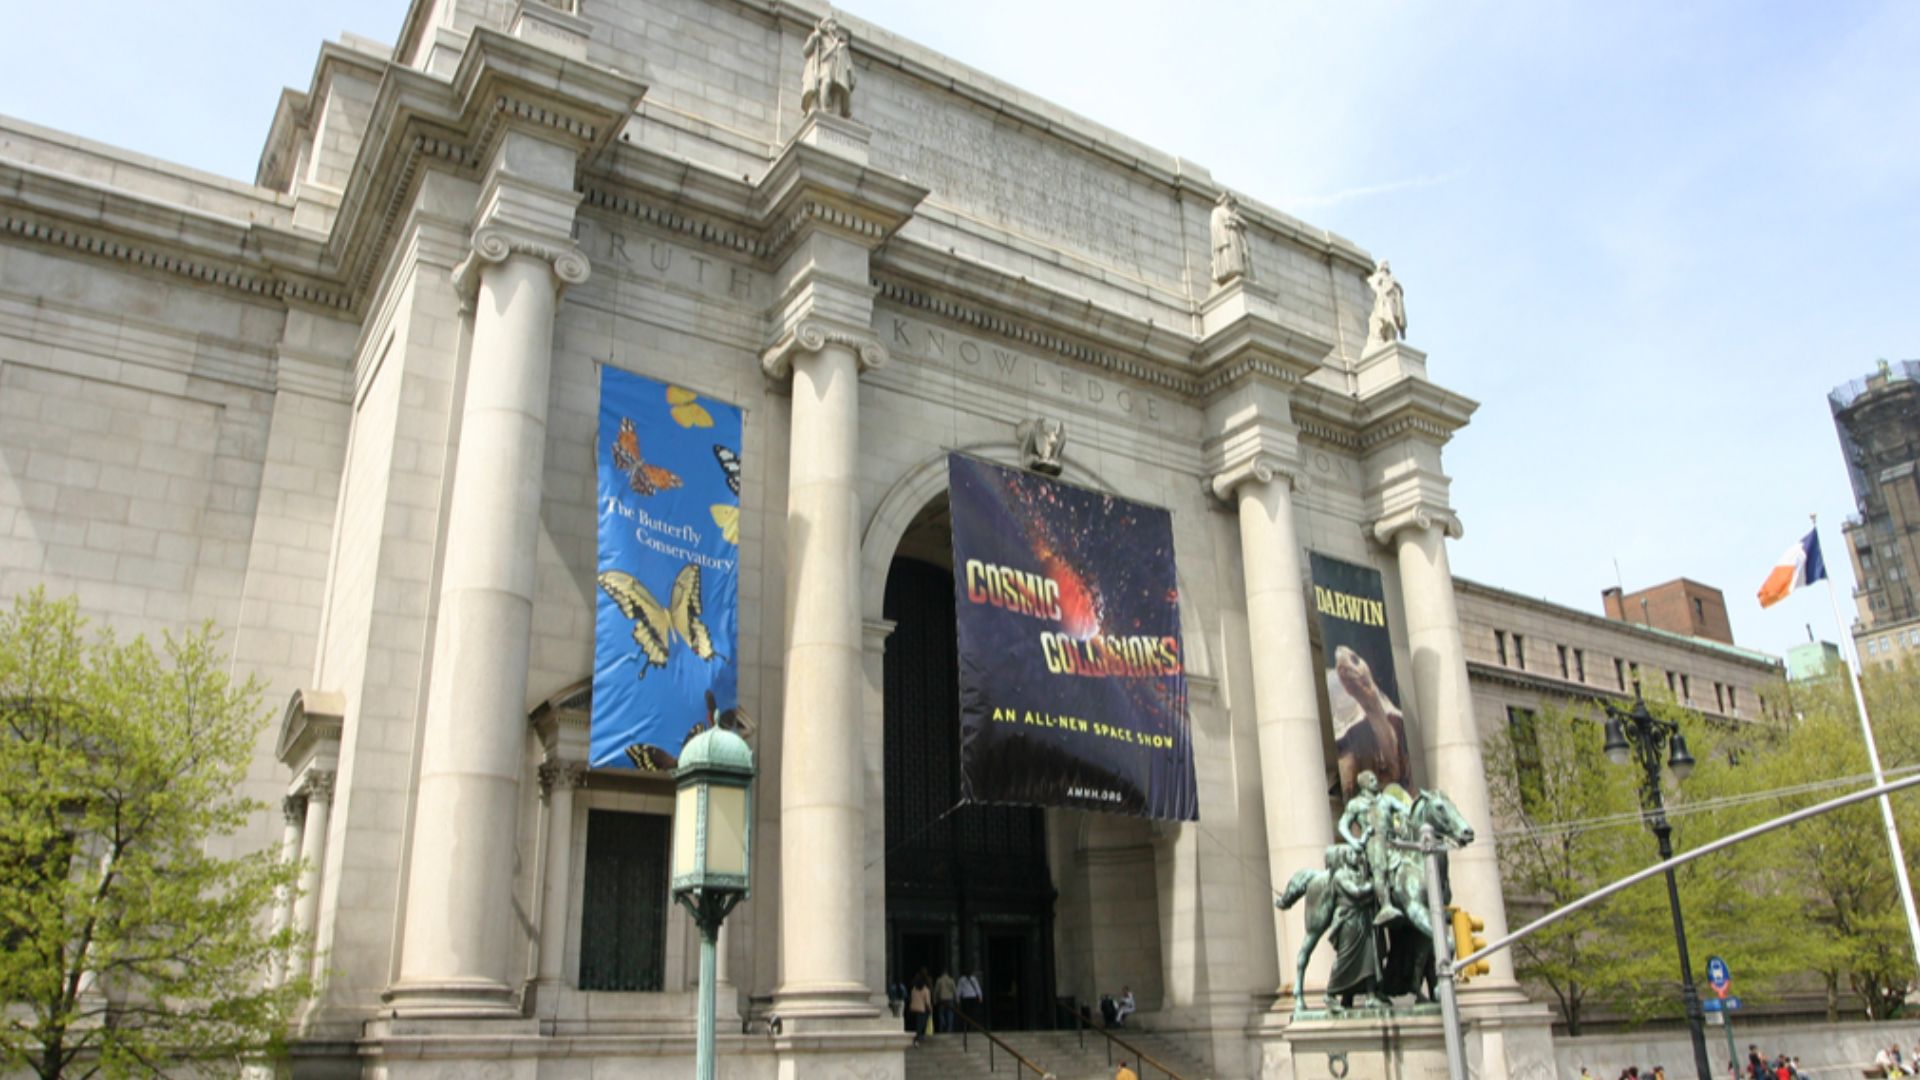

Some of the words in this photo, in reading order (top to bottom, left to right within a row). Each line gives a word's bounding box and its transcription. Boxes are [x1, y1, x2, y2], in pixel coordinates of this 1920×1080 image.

[893, 319, 1160, 421] KNOWLEDGE
[607, 496, 635, 519] The
[639, 509, 701, 547] Butterfly
[636, 528, 734, 573] Conservatory
[966, 559, 1063, 622] COSMIC
[1314, 586, 1385, 628] DARWIN
[1040, 631, 1182, 678] COLLISIONS
[992, 707, 1016, 722] AN
[1024, 709, 1088, 732] ALL-NEW
[1093, 722, 1133, 743] SPACE
[1137, 732, 1173, 750] SHOW
